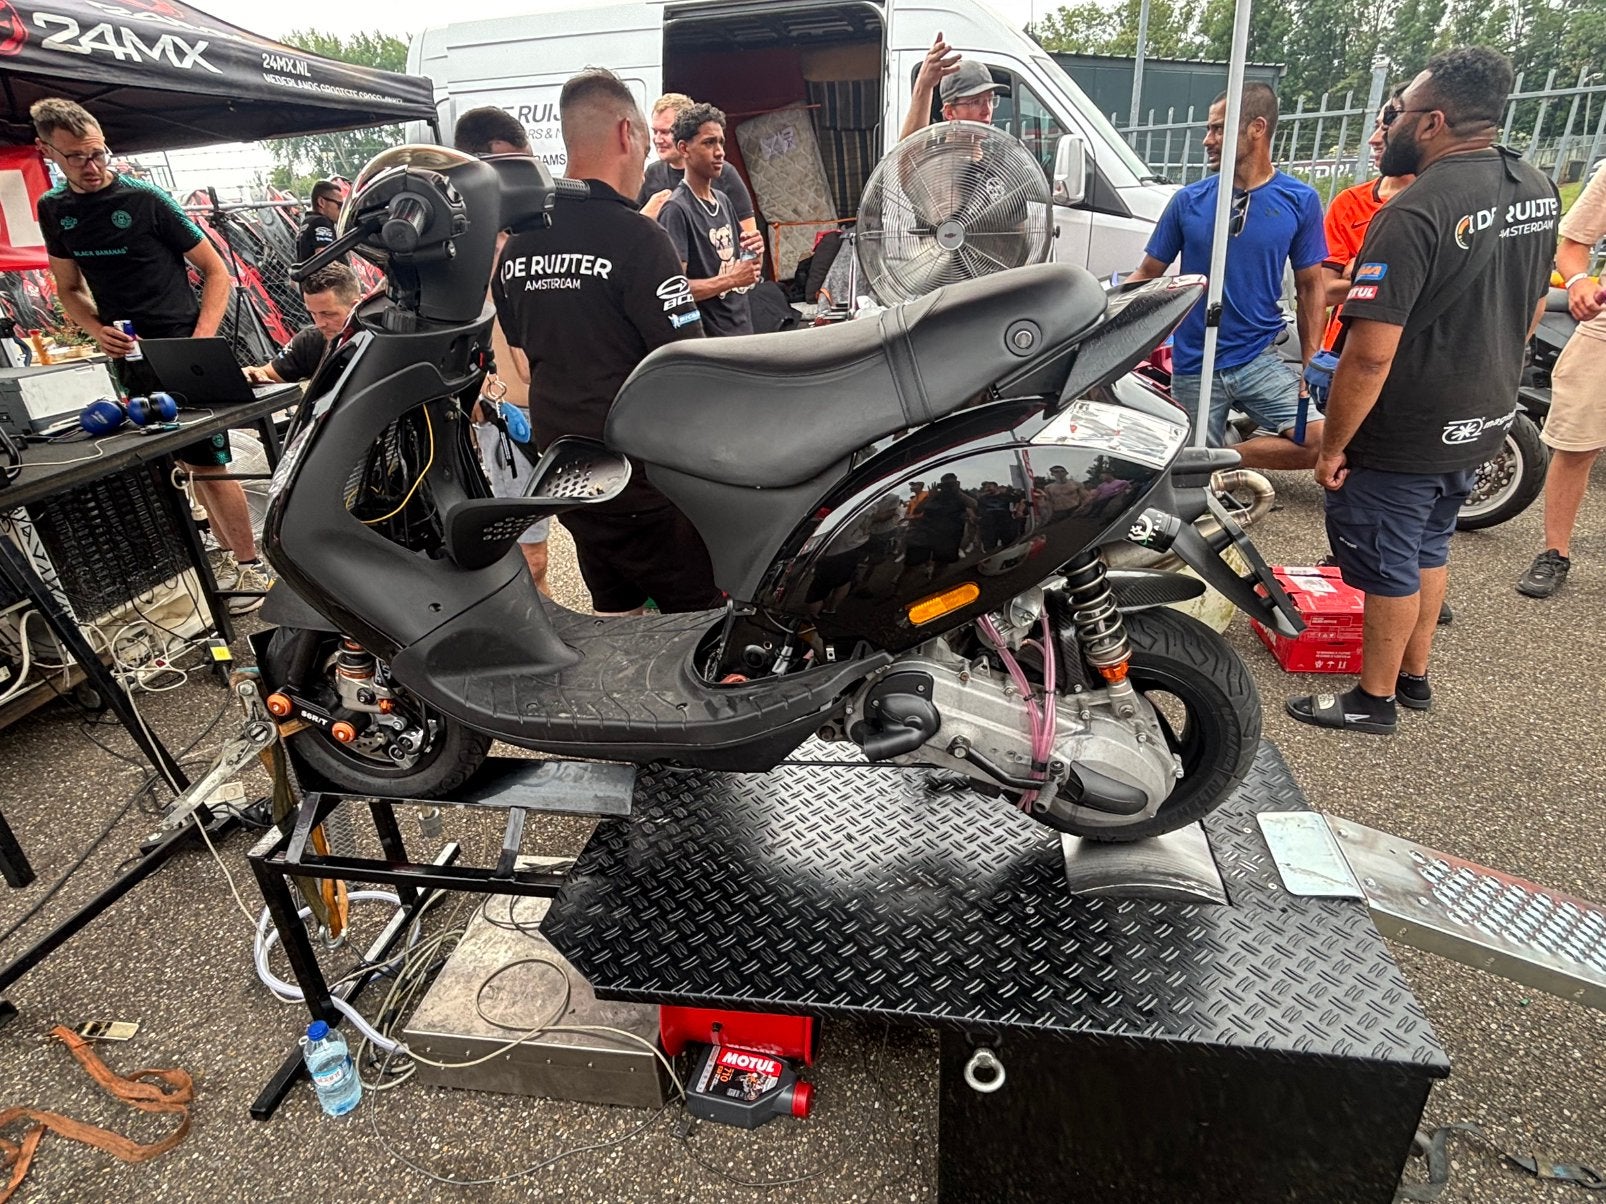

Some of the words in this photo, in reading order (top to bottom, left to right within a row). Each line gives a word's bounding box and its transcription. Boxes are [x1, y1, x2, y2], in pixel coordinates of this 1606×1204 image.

[32, 12, 223, 74] 24MX
[262, 53, 311, 77] 24MX.NL
[504, 257, 527, 280] DE
[530, 254, 613, 279] RUIJTER
[524, 277, 581, 292] AMSTERDAM
[722, 1051, 775, 1073] MOTUL
